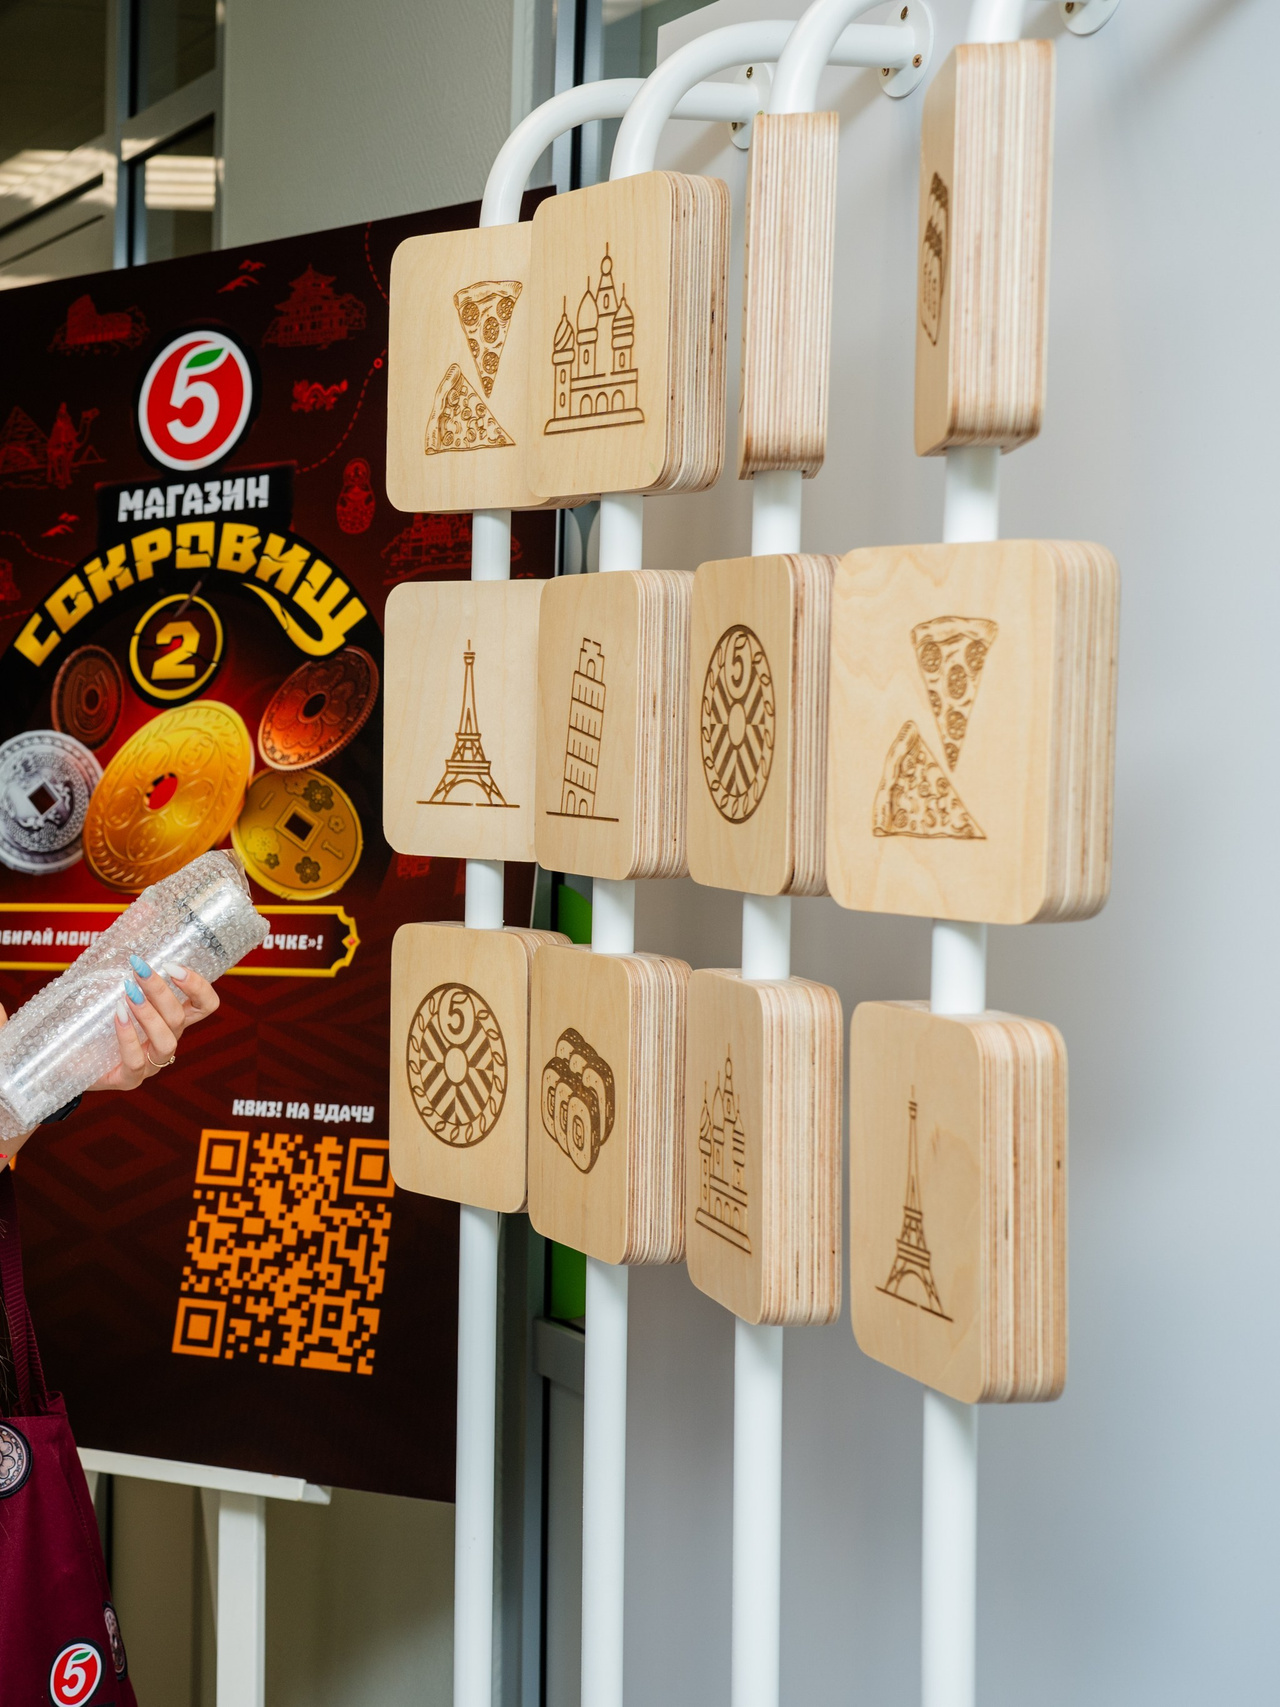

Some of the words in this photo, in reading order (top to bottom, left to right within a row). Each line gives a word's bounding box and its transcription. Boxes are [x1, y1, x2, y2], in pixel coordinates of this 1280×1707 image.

[118, 474, 270, 523] МАГАЗИН
[14, 520, 368, 668] СОКРОВИЩ
[151, 620, 201, 681] 2
[55, 930, 104, 946] МОНЕ
[262, 934, 324, 950] ОЧКЕ»!
[232, 1098, 283, 1118] КВИЗ!
[285, 1101, 310, 1120] НА
[313, 1103, 375, 1123] УДАЧУ
